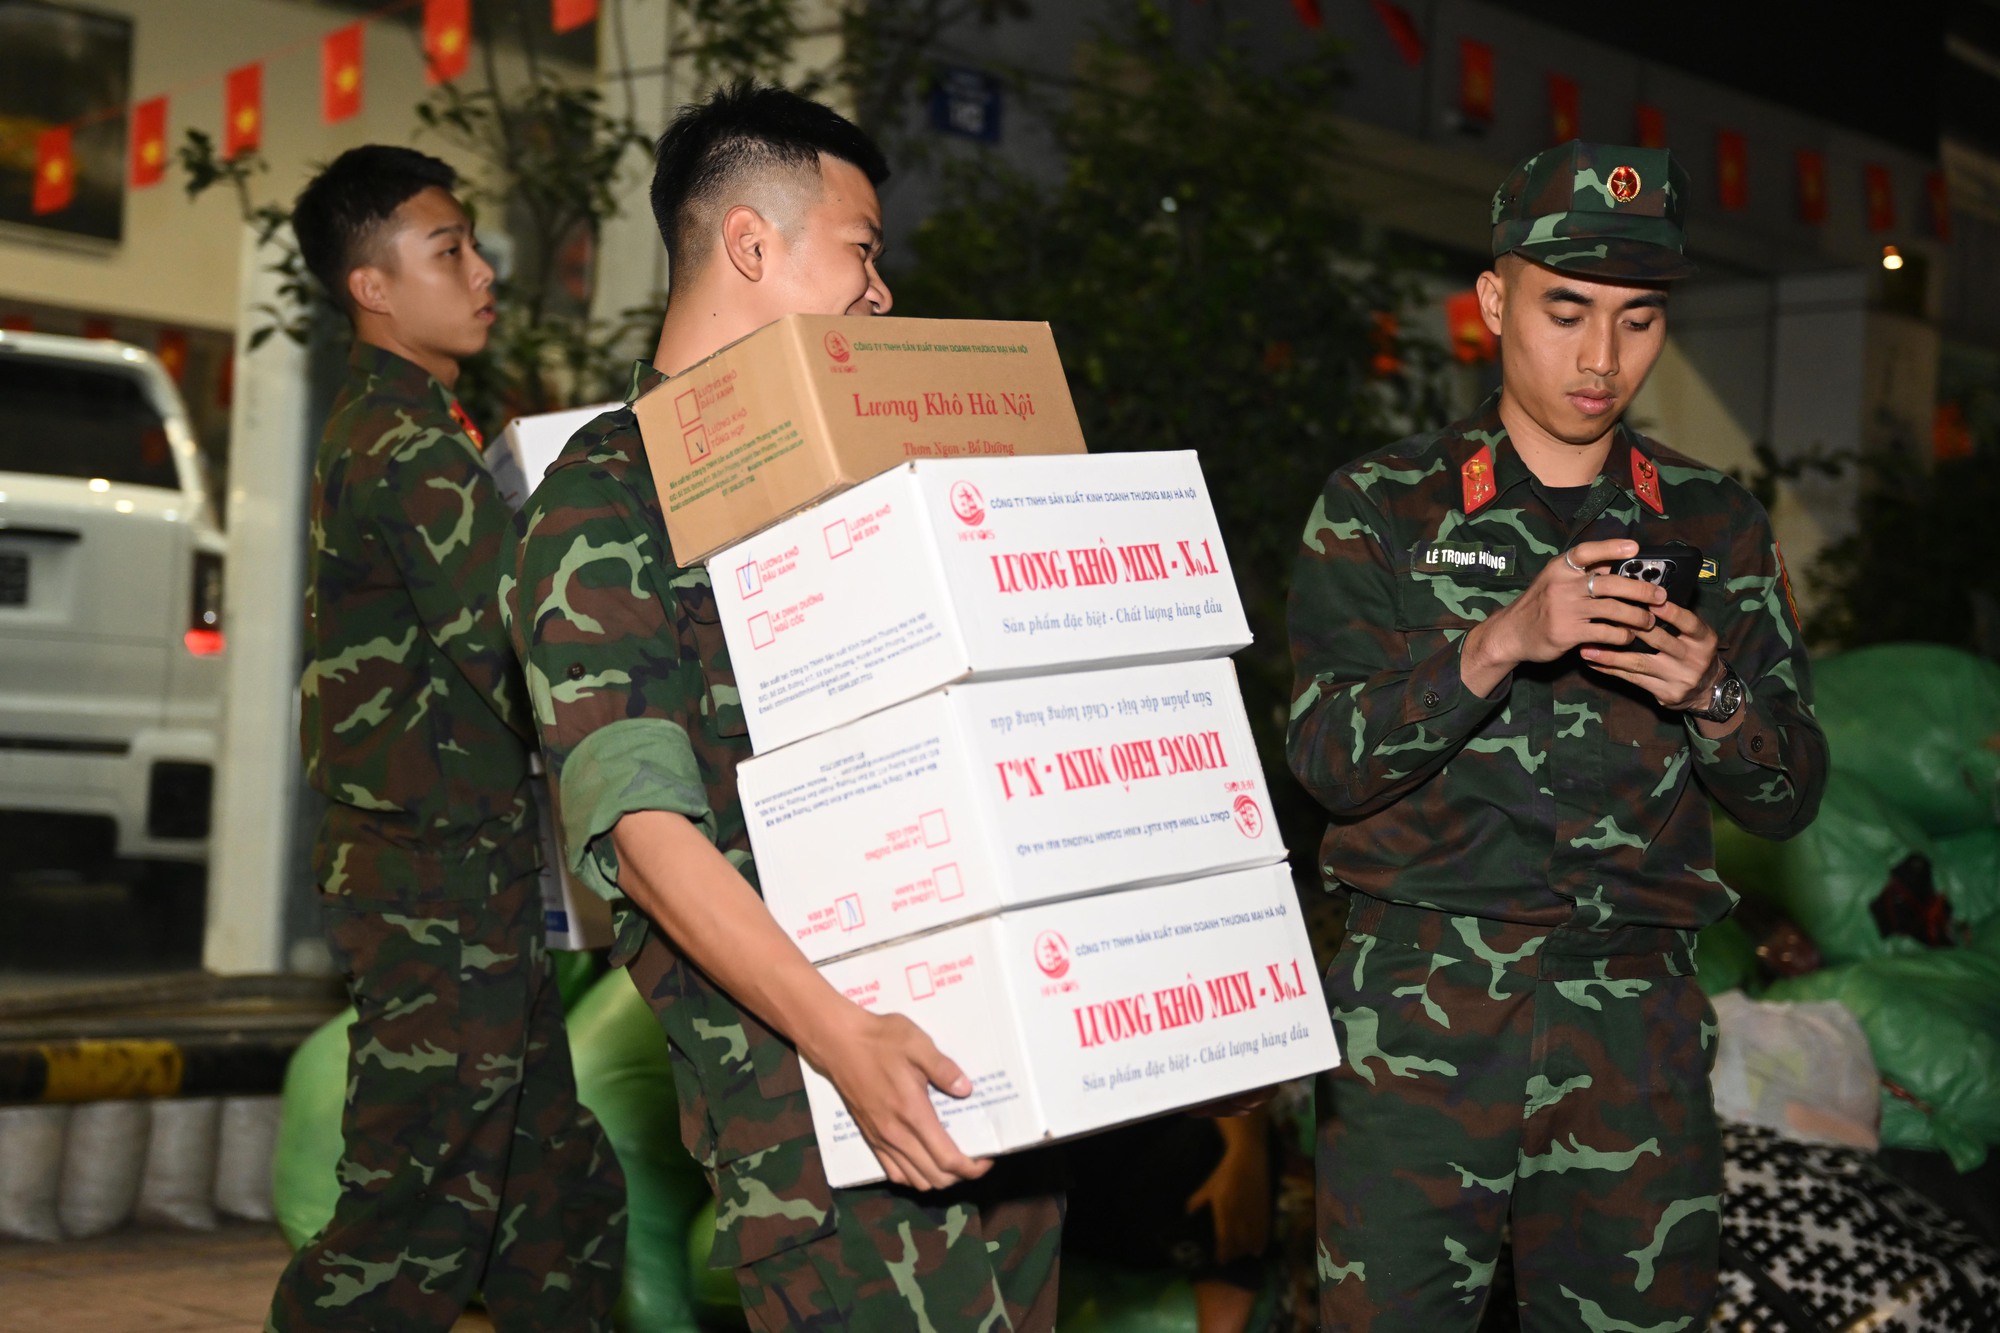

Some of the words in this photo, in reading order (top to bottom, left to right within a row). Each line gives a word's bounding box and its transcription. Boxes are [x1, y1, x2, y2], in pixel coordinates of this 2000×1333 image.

[852, 393, 919, 423] Lương
[923, 392, 963, 416] Khô
[967, 393, 999, 415] Hà
[1001, 393, 1036, 421] Nội
[990, 497, 1013, 509] CÔNG
[1014, 497, 1024, 507] TY
[1026, 497, 1048, 507] TNHH
[1048, 492, 1064, 505] SẢN
[1065, 491, 1085, 504] XUẤT
[1086, 493, 1103, 503] KINH
[1104, 492, 1130, 502] DOANH
[1130, 491, 1160, 501] THƯƠNG
[1160, 490, 1174, 502] MẠI
[1174, 488, 1185, 499] HÀ
[1185, 487, 1197, 500] NỘI
[990, 550, 1068, 594] LƯƠNG
[1066, 537, 1118, 587] KHÔ
[1117, 544, 1169, 582] MINI
[1425, 548, 1439, 564] LÊ
[1441, 549, 1476, 568] TRỌNG
[1479, 550, 1506, 570] HÙNG
[1003, 617, 1026, 634] Sản
[1029, 613, 1061, 636] phẩm
[1064, 613, 1083, 631] đặc
[1086, 611, 1107, 629] biệt
[1116, 605, 1142, 623] Chất
[1144, 606, 1174, 622] lượng
[1175, 602, 1202, 619] hàng
[1204, 597, 1223, 615] đầu
[1055, 747, 1111, 792] MINI
[1111, 739, 1162, 794] KHÔ
[1160, 730, 1229, 776] LƯƠNG
[1073, 994, 1153, 1048] LƯƠNG
[1152, 973, 1205, 1031] KHÔ
[1205, 971, 1258, 1019] MINI
